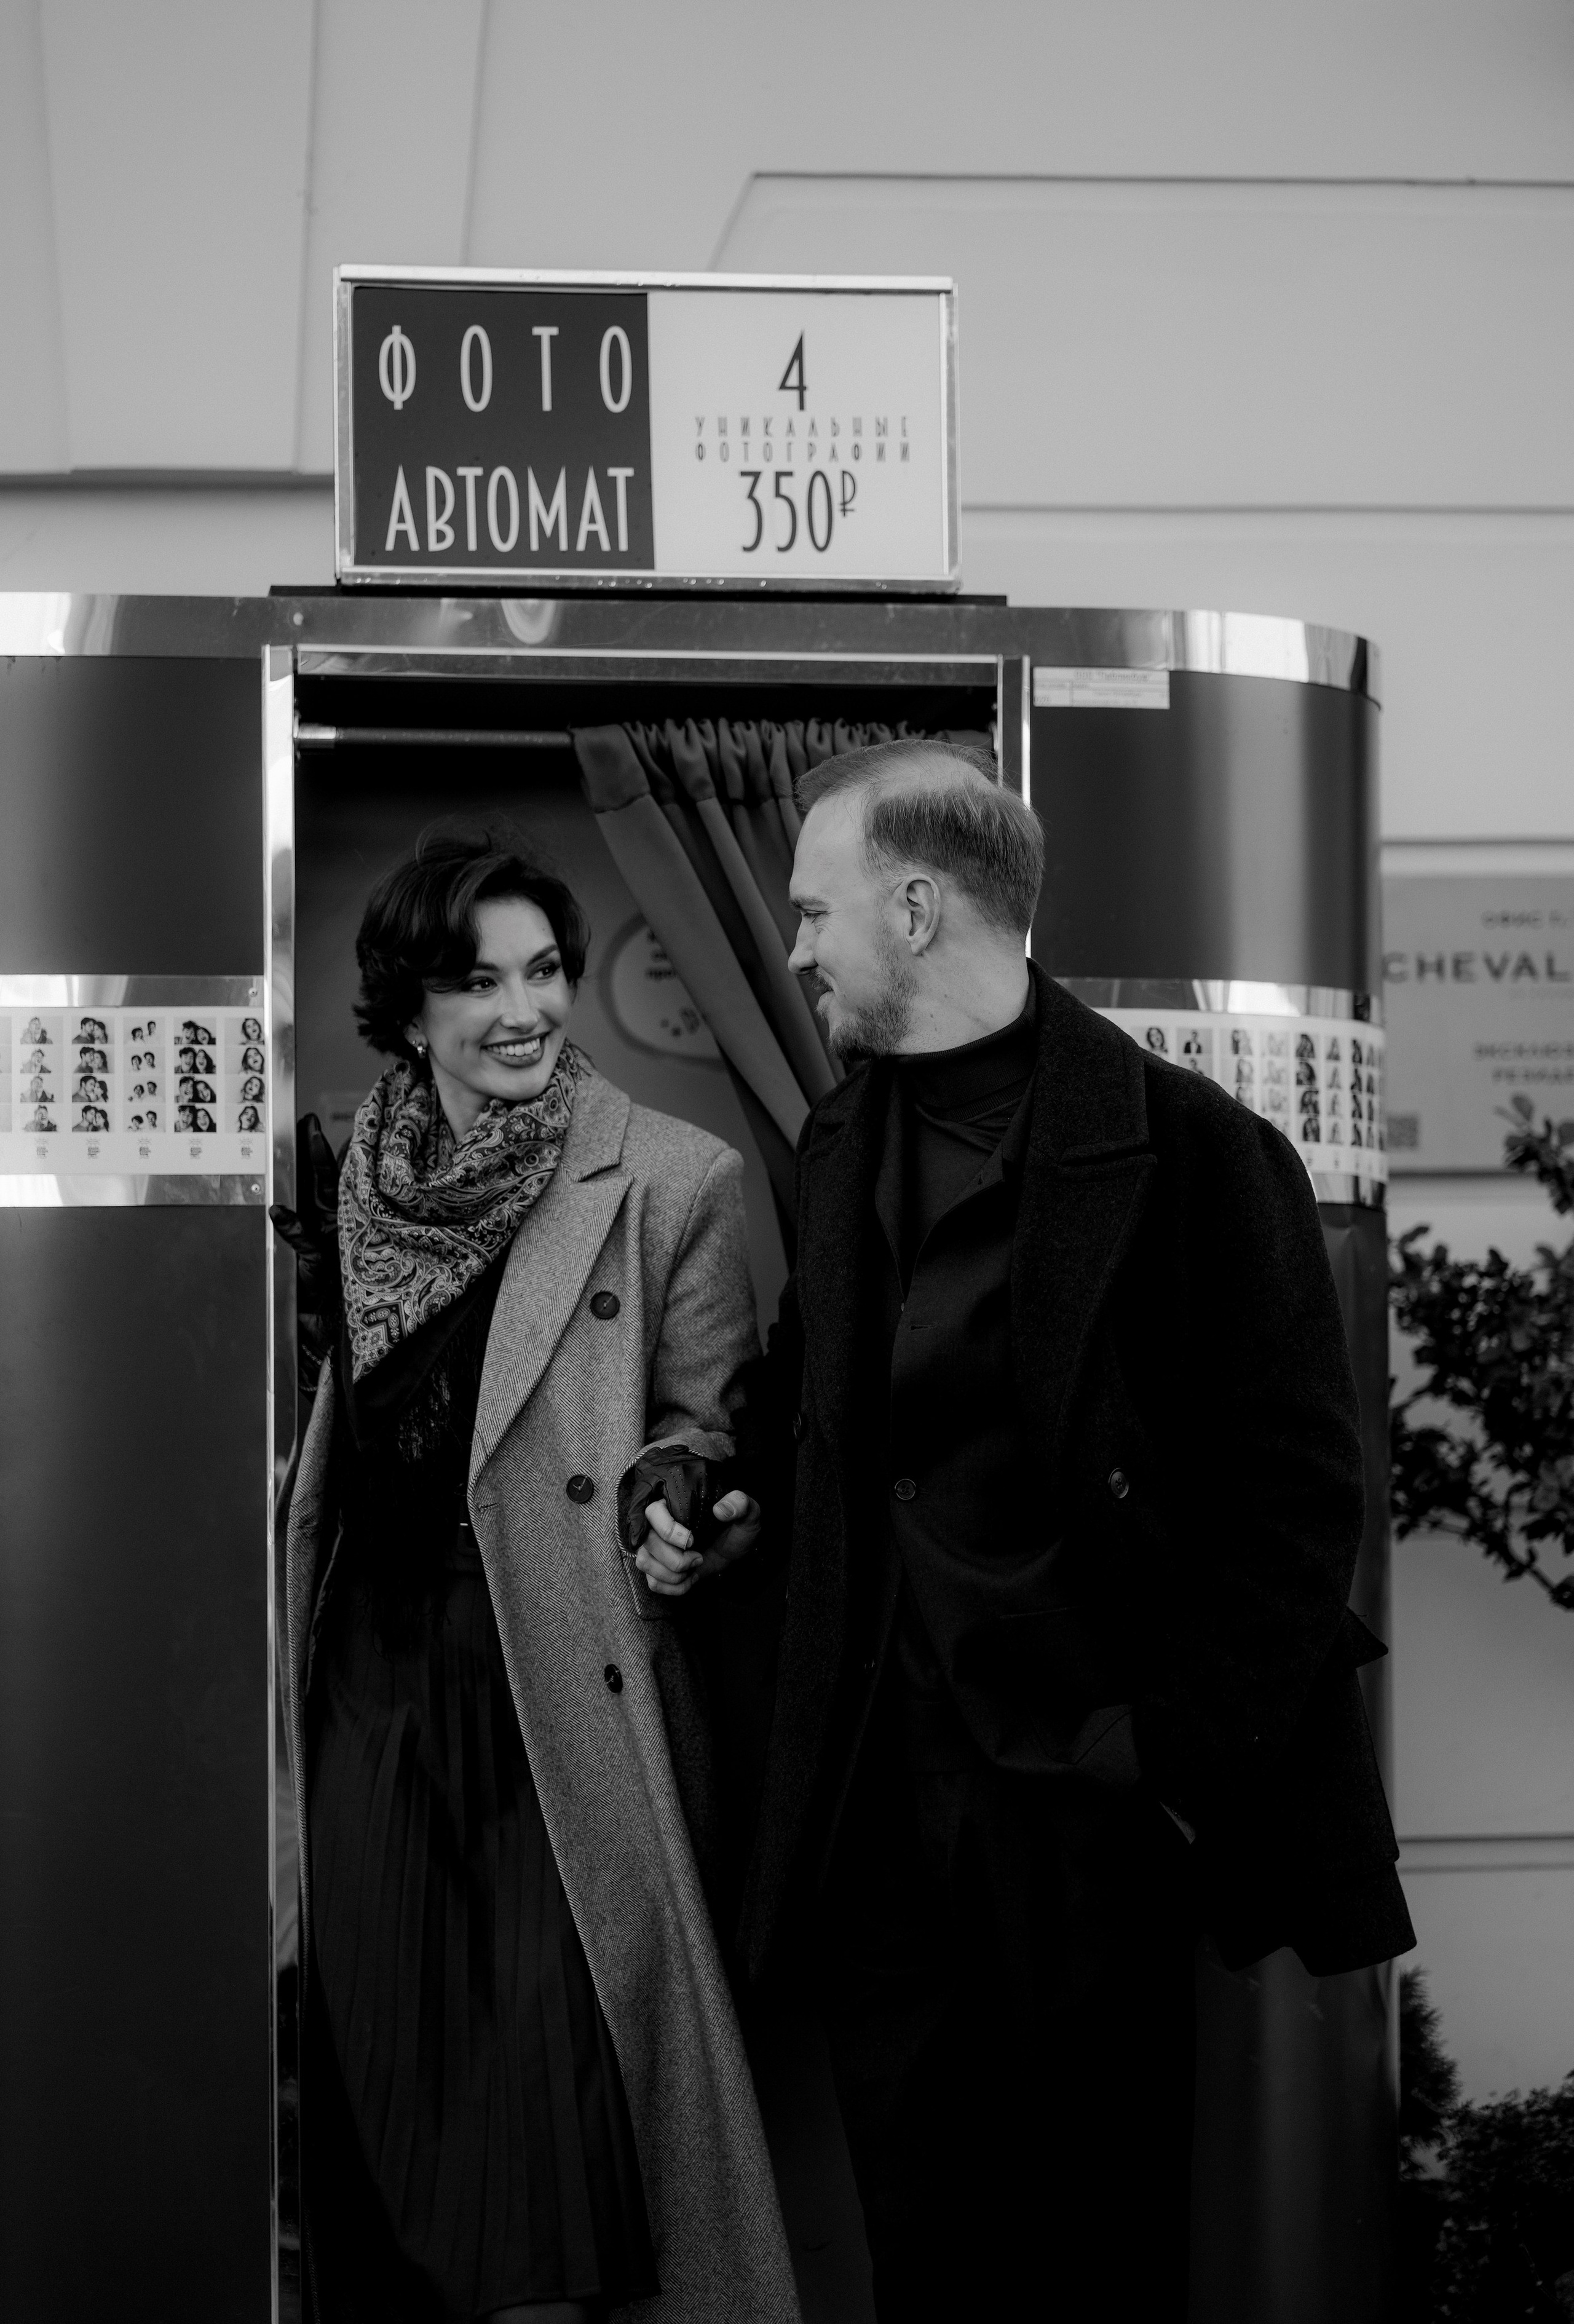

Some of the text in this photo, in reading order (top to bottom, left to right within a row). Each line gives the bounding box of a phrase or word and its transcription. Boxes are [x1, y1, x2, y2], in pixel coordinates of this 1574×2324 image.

[378, 323, 633, 414] ФОТО
[777, 328, 809, 412] 4
[695, 416, 907, 438] УНИКАЛЬНЫЕ
[695, 441, 911, 462] ФОТОГРАФИИ
[385, 464, 635, 553] АВТОМАТ
[1382, 952, 1572, 983] CHEVAL
